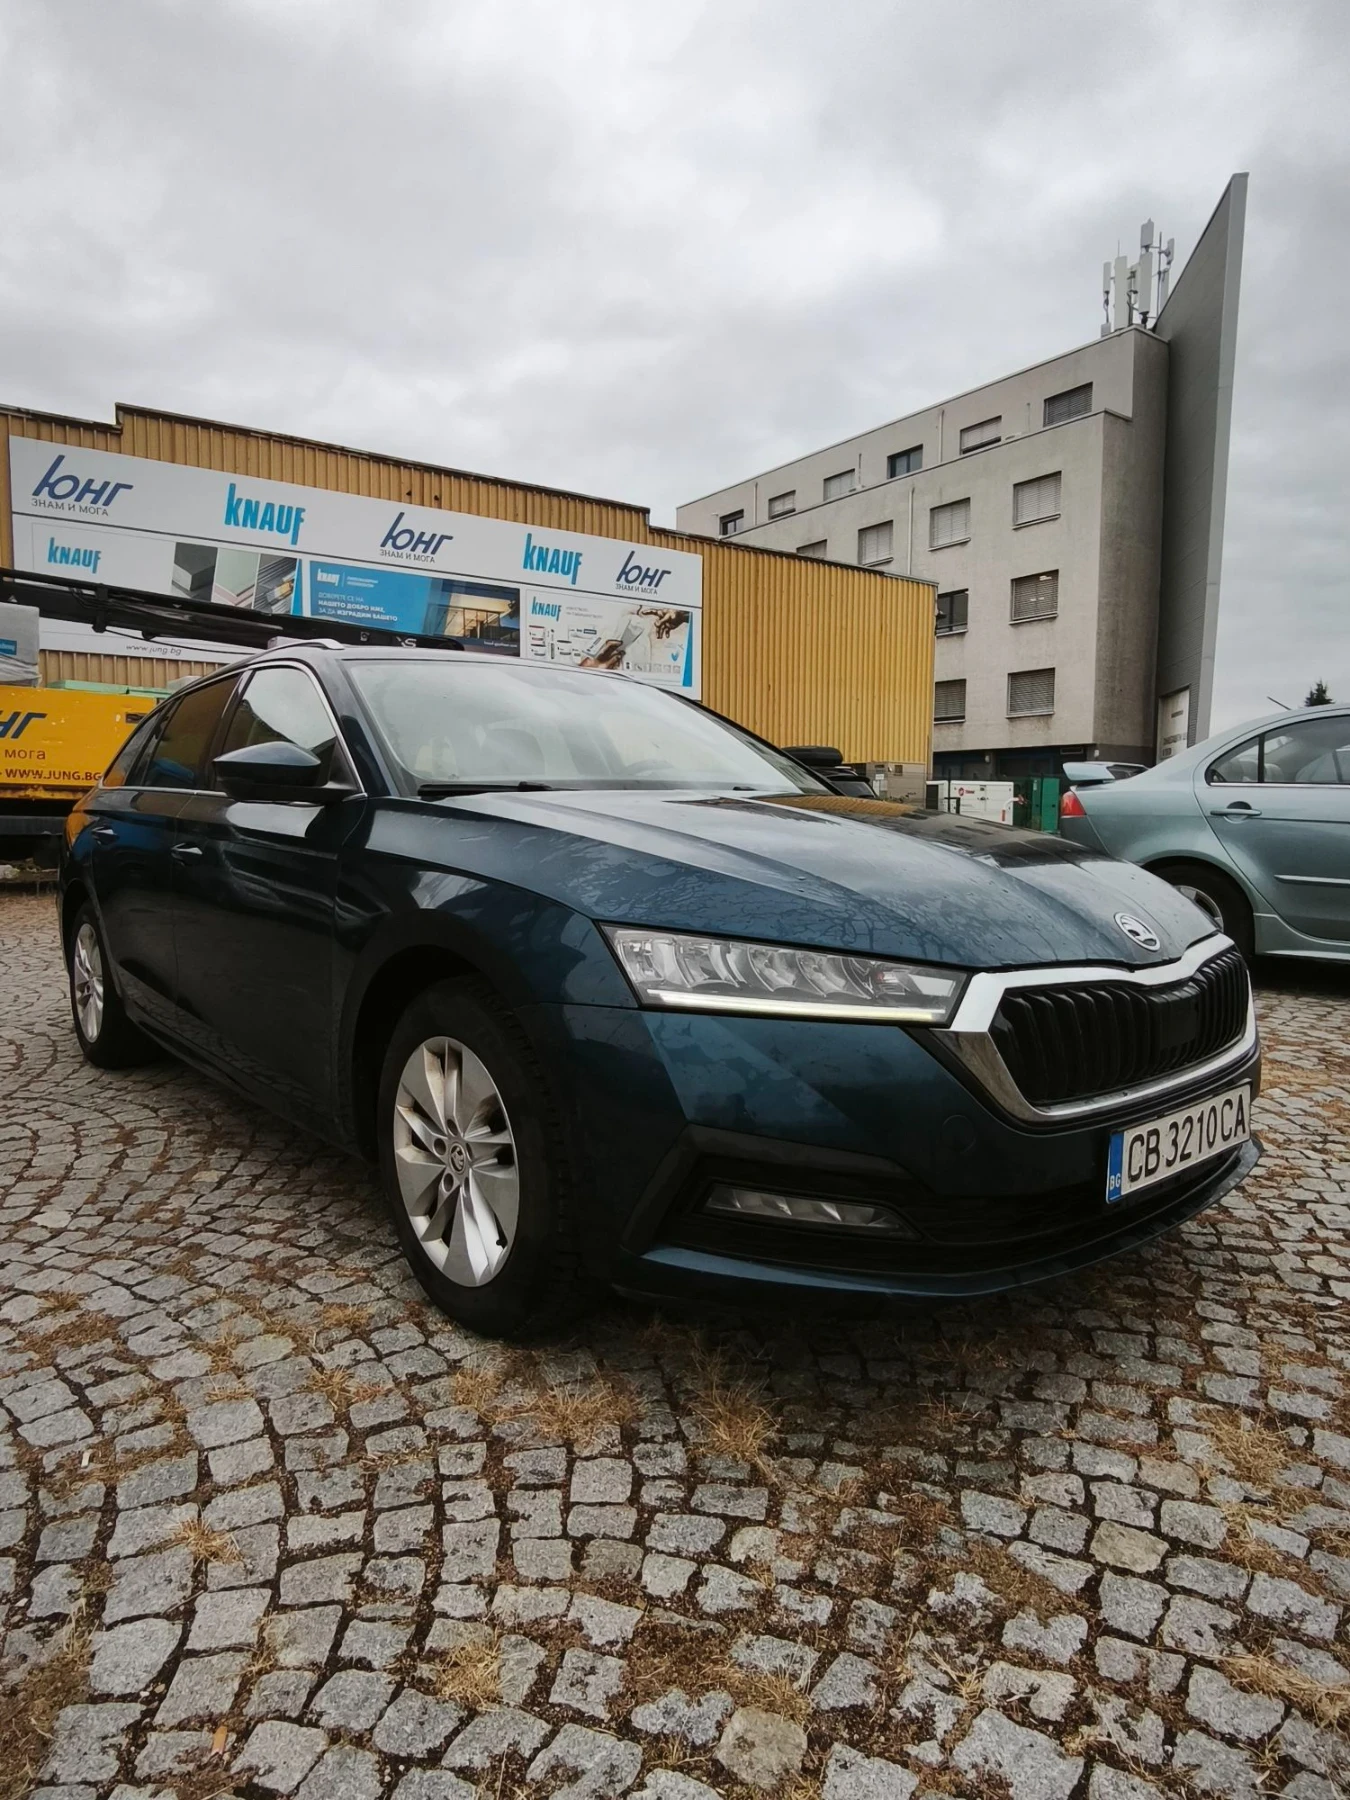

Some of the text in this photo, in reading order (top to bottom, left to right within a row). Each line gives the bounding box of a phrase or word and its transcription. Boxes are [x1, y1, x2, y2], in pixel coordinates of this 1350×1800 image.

[31, 497, 109, 516] ЗНАМ И МОГА
[379, 549, 436, 564] ЗНАМ И МОГА
[615, 583, 634, 592] ЗНАМ
[640, 587, 658, 596] МОГА
[1109, 1172, 1122, 1190] BG
